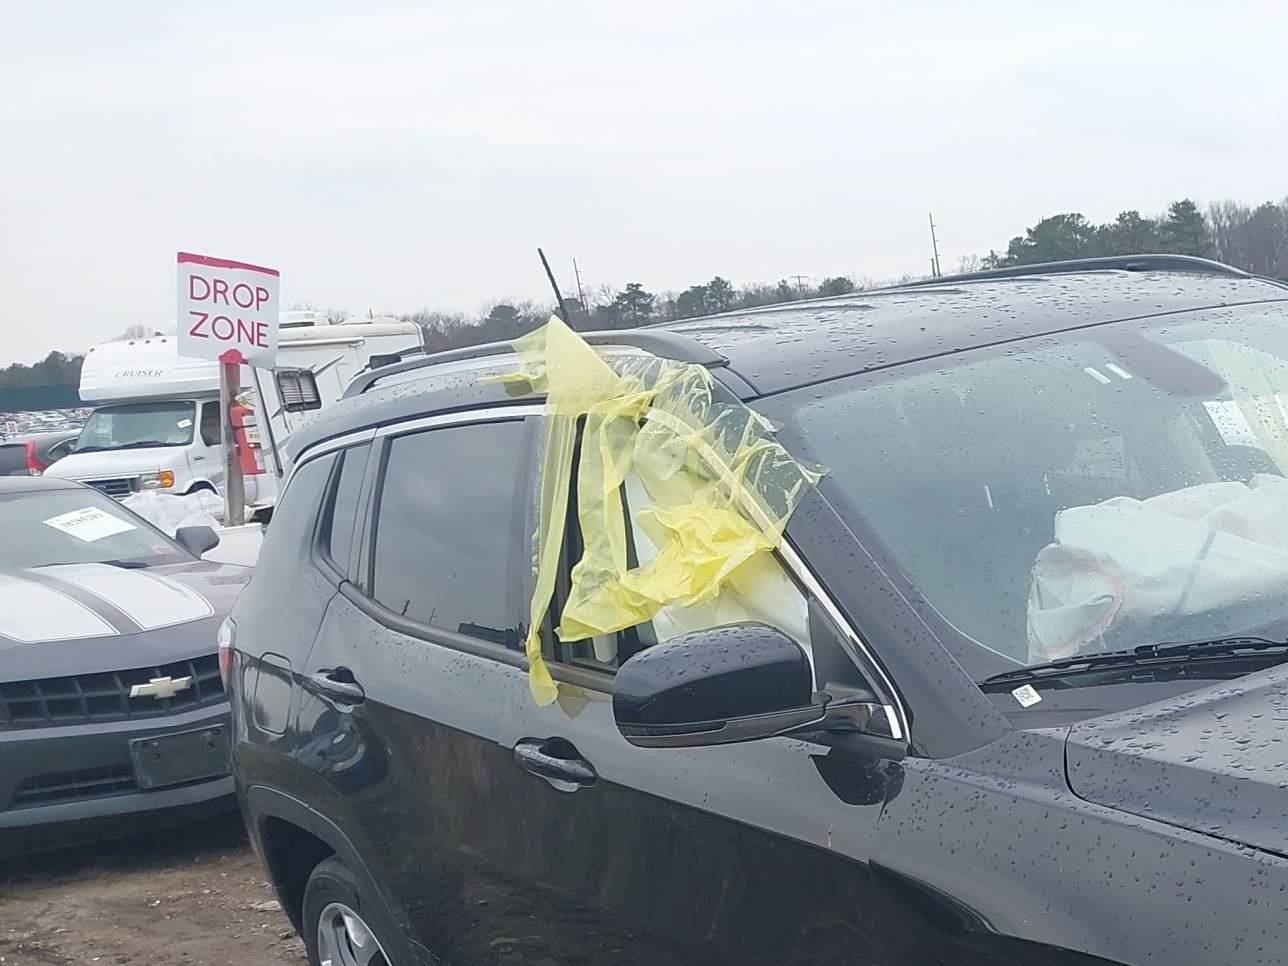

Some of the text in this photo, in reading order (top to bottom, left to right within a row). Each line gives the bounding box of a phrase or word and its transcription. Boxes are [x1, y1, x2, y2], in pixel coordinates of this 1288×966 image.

[190, 275, 269, 311] DROP
[190, 311, 269, 348] ZONE
[114, 368, 163, 378] CRUISER
